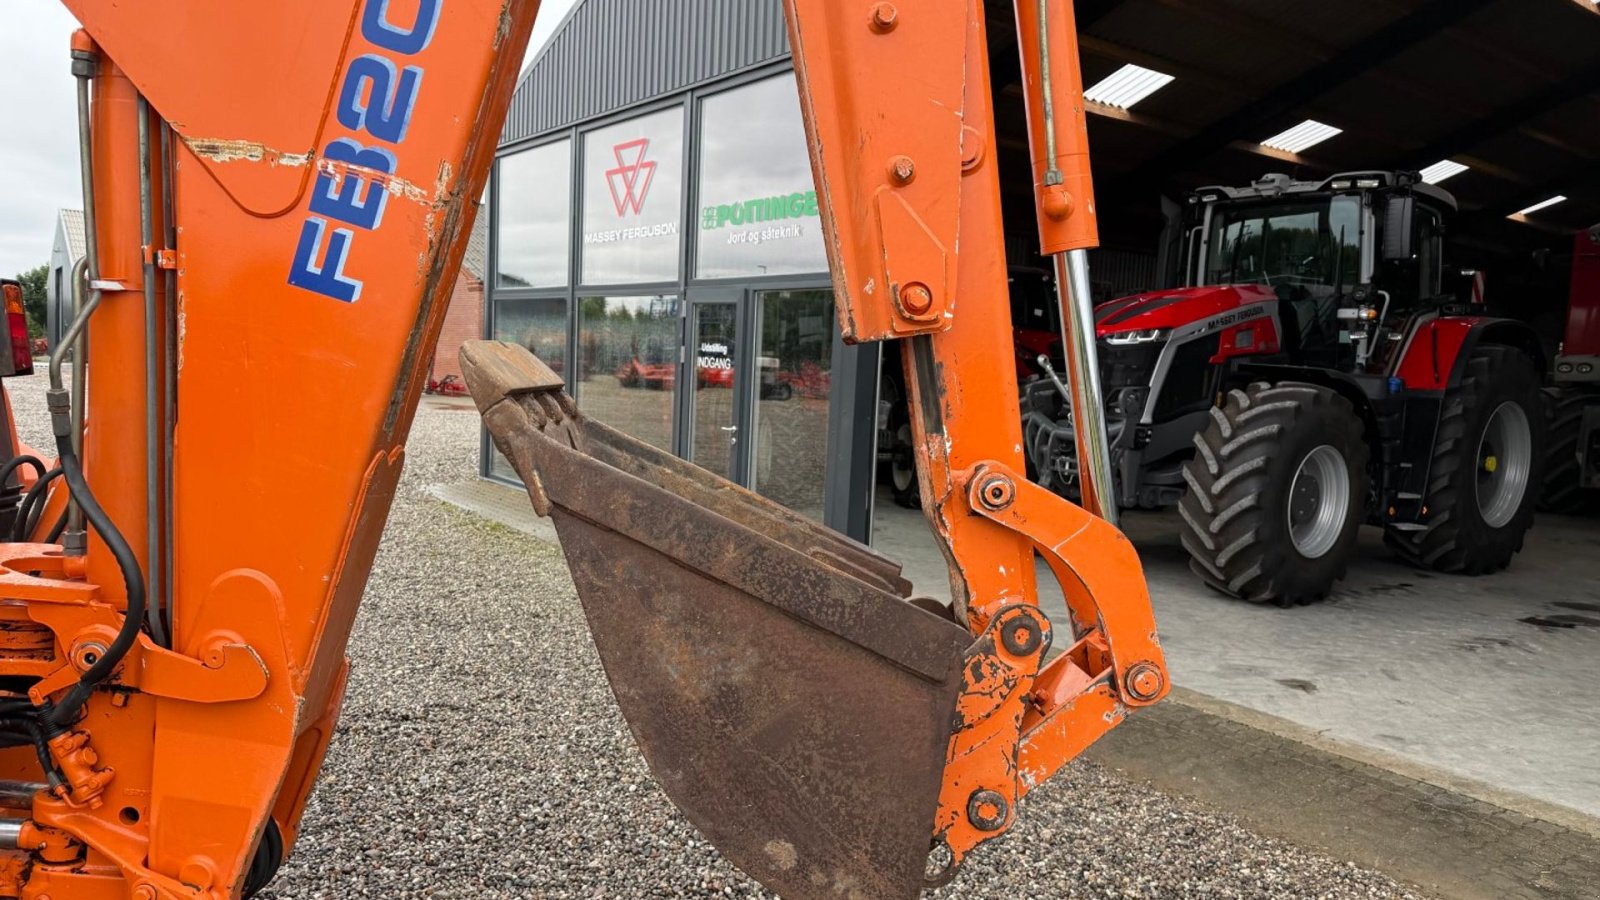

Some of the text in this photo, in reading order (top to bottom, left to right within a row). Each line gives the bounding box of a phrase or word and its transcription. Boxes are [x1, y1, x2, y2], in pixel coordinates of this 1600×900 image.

[585, 222, 676, 244] MASSEY FERGUSON
[727, 224, 800, 244] Jord og såteknik
[697, 356, 731, 369] INDGANG
